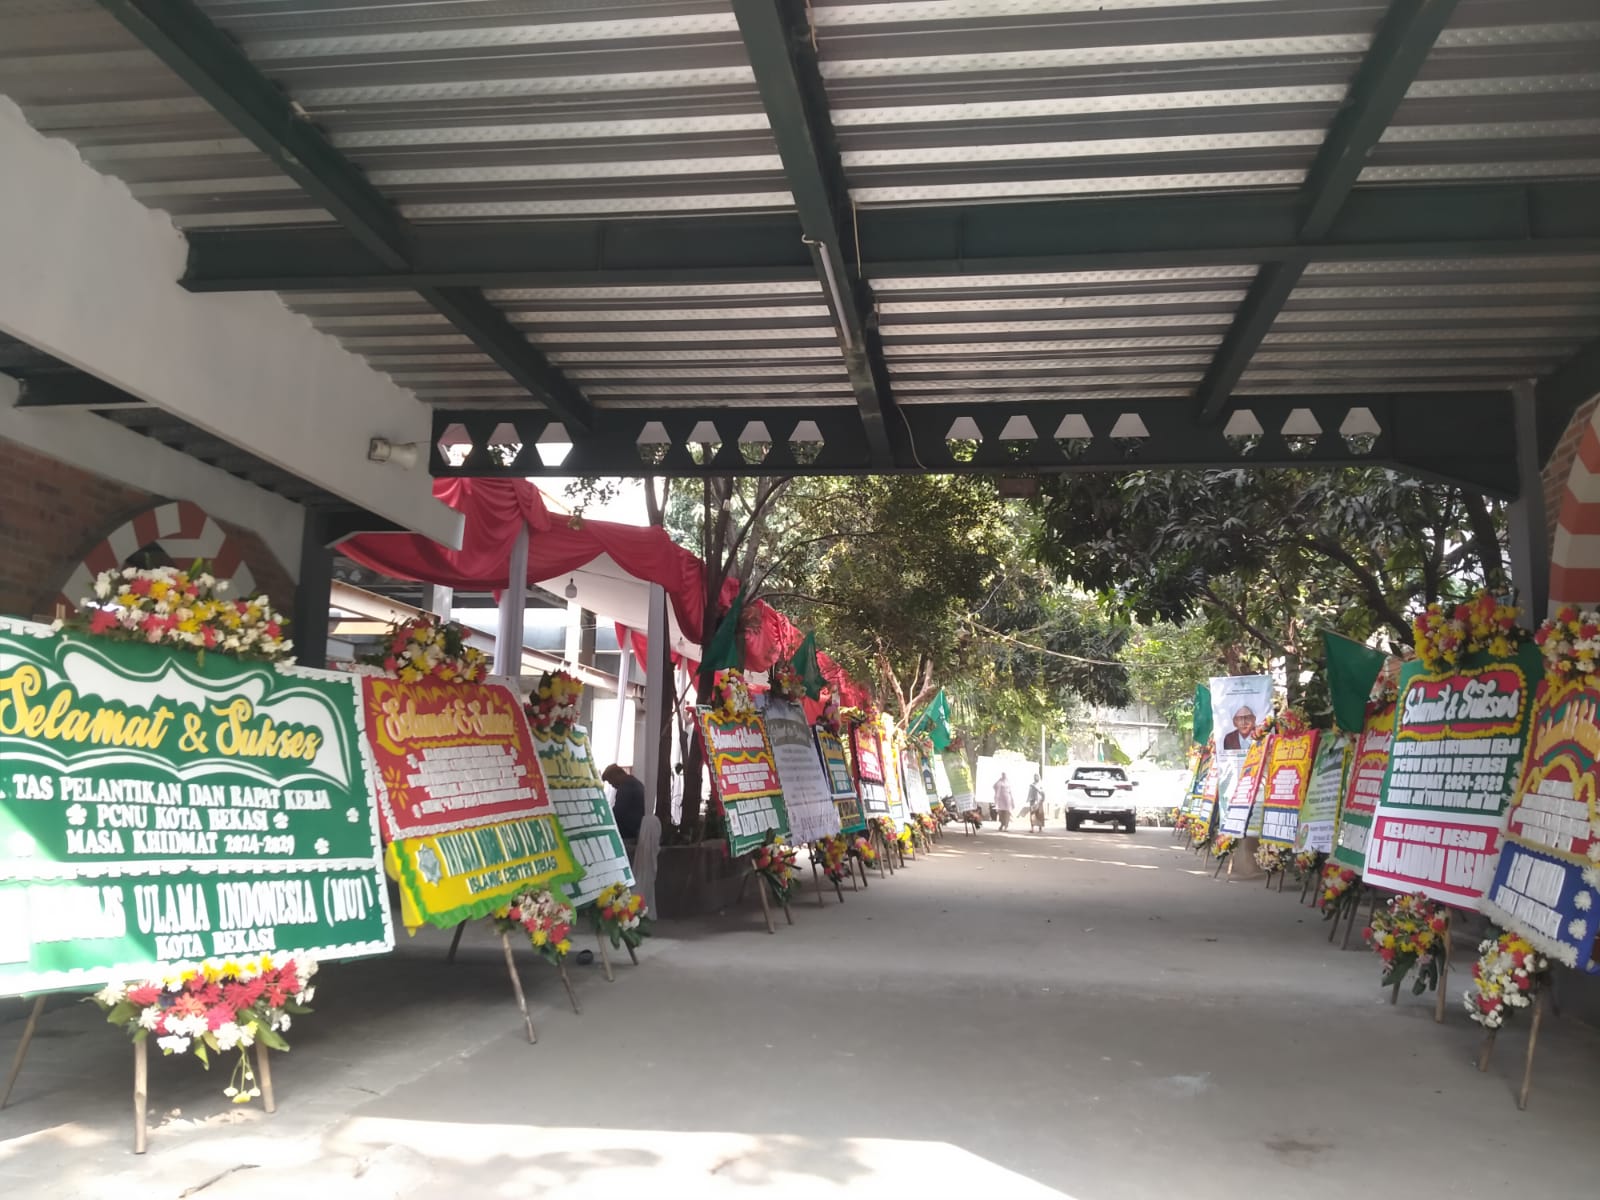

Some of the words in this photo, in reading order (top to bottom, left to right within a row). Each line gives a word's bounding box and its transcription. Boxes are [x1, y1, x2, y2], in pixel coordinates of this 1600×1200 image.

[0, 665, 175, 749] Selamat
[178, 712, 209, 753] &
[210, 699, 322, 760] Sukses
[59, 776, 182, 806] PELANTIKAN
[188, 784, 225, 807] DAN
[230, 785, 281, 809] RAPAT
[96, 804, 148, 829] PCNU
[154, 806, 203, 831] KOTA
[207, 808, 270, 832] BEKASI
[65, 829, 125, 854] MASA
[132, 829, 218, 855] KHIDMAT
[133, 883, 211, 934] ULAMA
[216, 880, 319, 931] INDONESIA
[154, 933, 206, 961] KOTA
[212, 928, 277, 956] BEKASI
